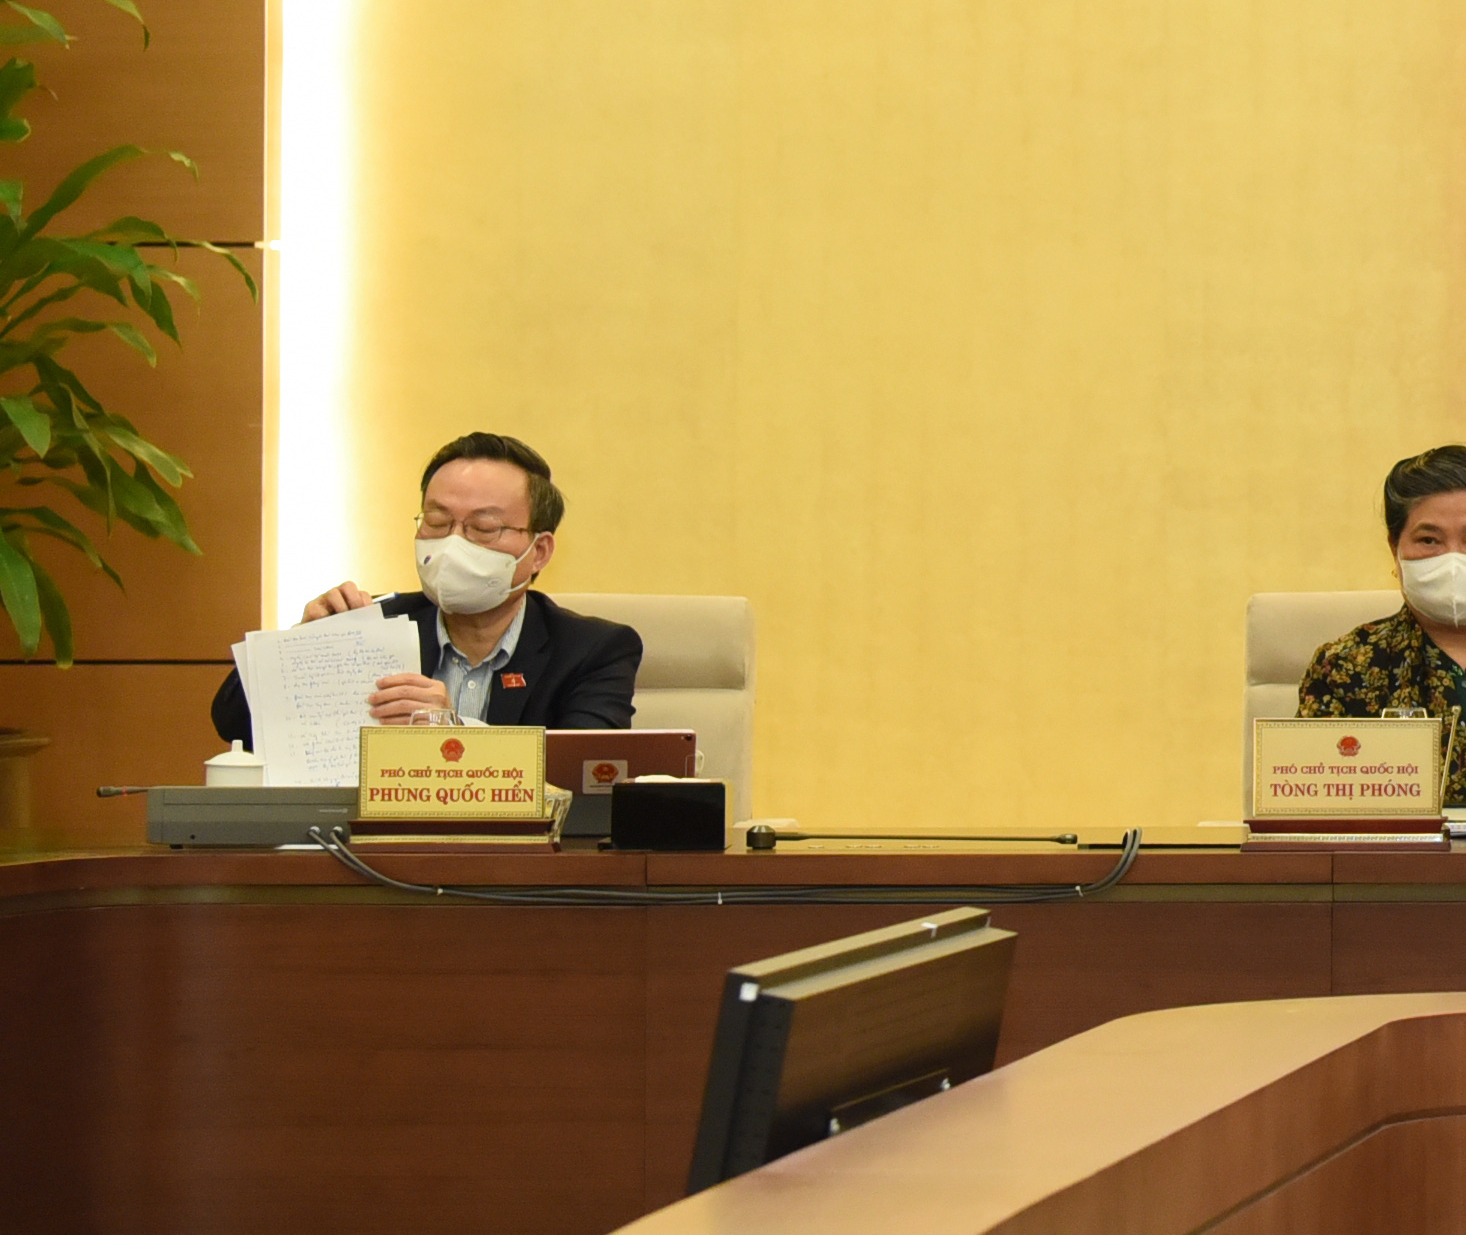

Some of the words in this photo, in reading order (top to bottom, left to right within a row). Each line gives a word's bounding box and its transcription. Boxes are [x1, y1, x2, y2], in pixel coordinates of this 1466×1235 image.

[380, 767, 405, 778] PHÓ
[408, 766, 432, 778] CHỦ
[435, 769, 463, 780] TỊCH
[466, 766, 499, 778] QUỐC
[502, 767, 524, 780] HỘI
[1272, 764, 1298, 774] PHÓ
[1300, 762, 1325, 774] CHỦ
[1328, 765, 1357, 777] TỊCH
[1360, 762, 1394, 774] QUỐC
[1396, 763, 1418, 776] HỘI
[369, 783, 431, 802] PHÙNG
[435, 782, 486, 805] QUỐC
[490, 780, 534, 802] HIỂN
[1270, 779, 1318, 797] TÒNG
[1323, 783, 1354, 800] THỊ
[1359, 779, 1421, 797] PHÓNG
